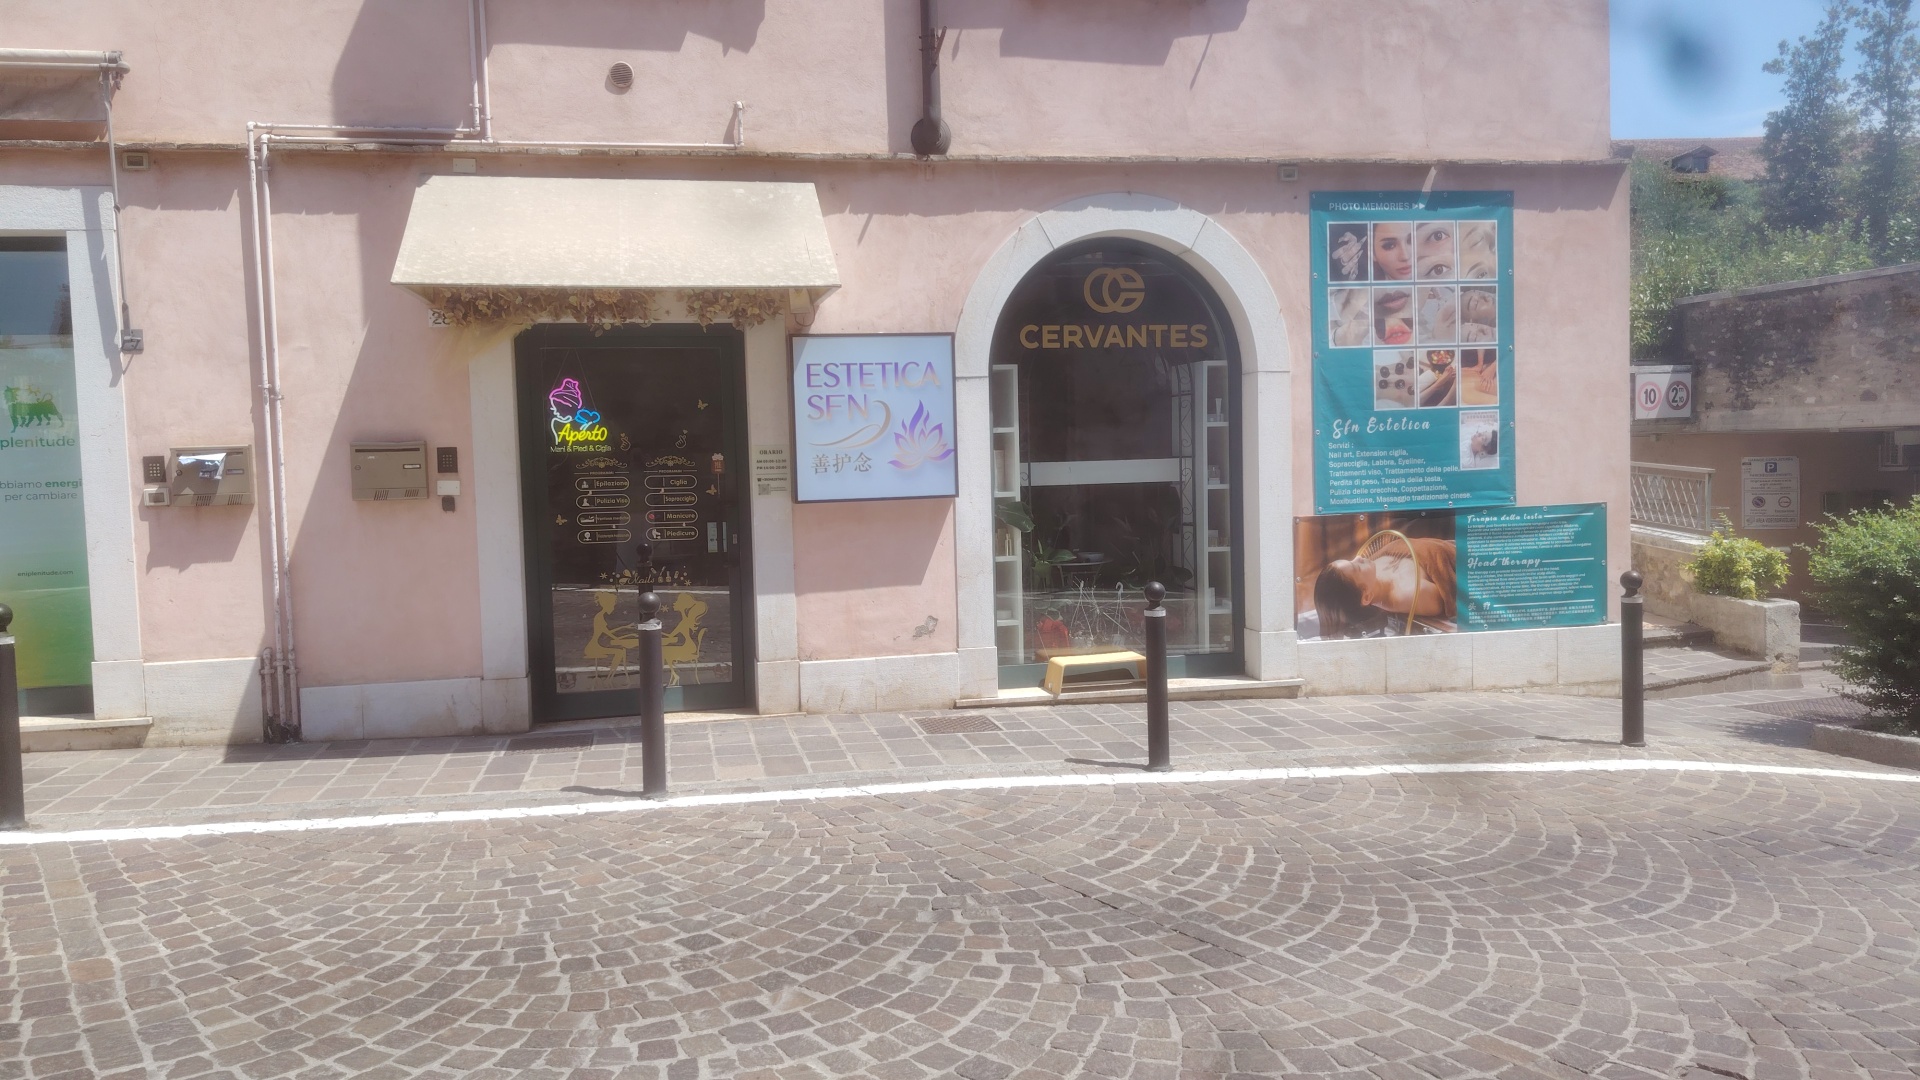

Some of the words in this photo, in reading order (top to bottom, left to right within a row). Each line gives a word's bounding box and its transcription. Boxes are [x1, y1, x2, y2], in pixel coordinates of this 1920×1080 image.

[1328, 202, 1360, 211] PHOTO
[1362, 202, 1410, 211] MEMORIES
[1019, 323, 1208, 349] CERVANTES
[806, 361, 941, 389] ESTETICA
[1643, 388, 1657, 405] 10
[807, 393, 868, 420] SFN
[1332, 418, 1360, 439] Sfn
[1366, 416, 1431, 434] Estetica
[557, 422, 608, 446] Aperto
[0, 435, 76, 450] plenitude
[1328, 441, 1350, 449] Servizi
[1328, 451, 1342, 459] Nail
[1388, 449, 1409, 457] ciglia,
[811, 451, 873, 475] 善护念
[1398, 458, 1426, 466] Eyeliner,
[1329, 468, 1366, 477] Trattamenti
[1384, 467, 1425, 475] Trattamento
[1425, 465, 1441, 473] della
[1329, 478, 1353, 486] Perdita
[1381, 477, 1406, 485] Terapia
[1407, 475, 1423, 483] della
[4, 493, 22, 502] per
[26, 491, 78, 501] cambiare
[1329, 488, 1351, 496] Pulizia
[1352, 487, 1369, 495] delle
[1376, 494, 1411, 503] Massaggio
[1411, 493, 1449, 501] tradizionale
[1467, 514, 1498, 523] Terapia
[1500, 513, 1521, 521] della
[1467, 557, 1498, 569] Head
[1498, 556, 1541, 568] therapy
[17, 569, 74, 577] eniplenitude.com
[627, 574, 655, 585] Nails
